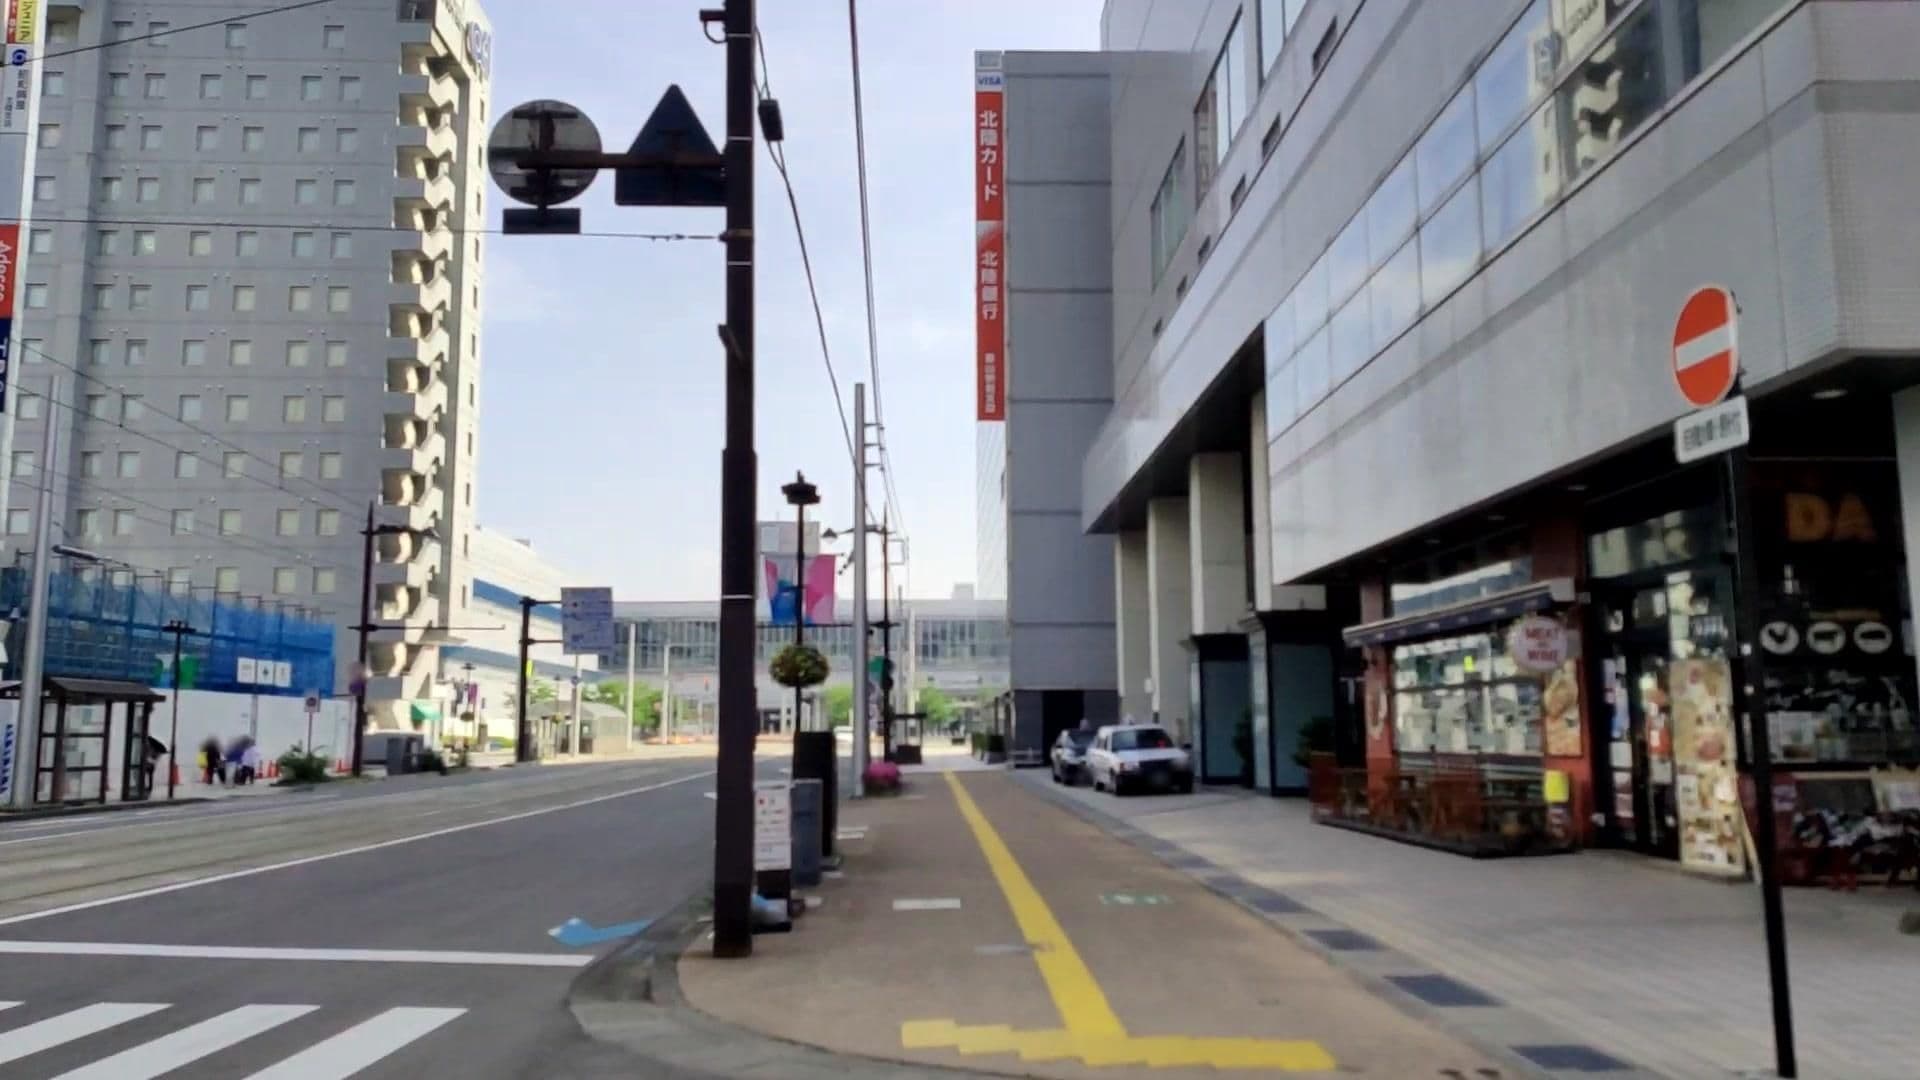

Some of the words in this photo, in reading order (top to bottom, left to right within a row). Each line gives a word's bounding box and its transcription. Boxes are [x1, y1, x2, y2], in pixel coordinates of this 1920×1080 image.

[978, 76, 1001, 86] VISA
[979, 110, 998, 202] 北陸カード
